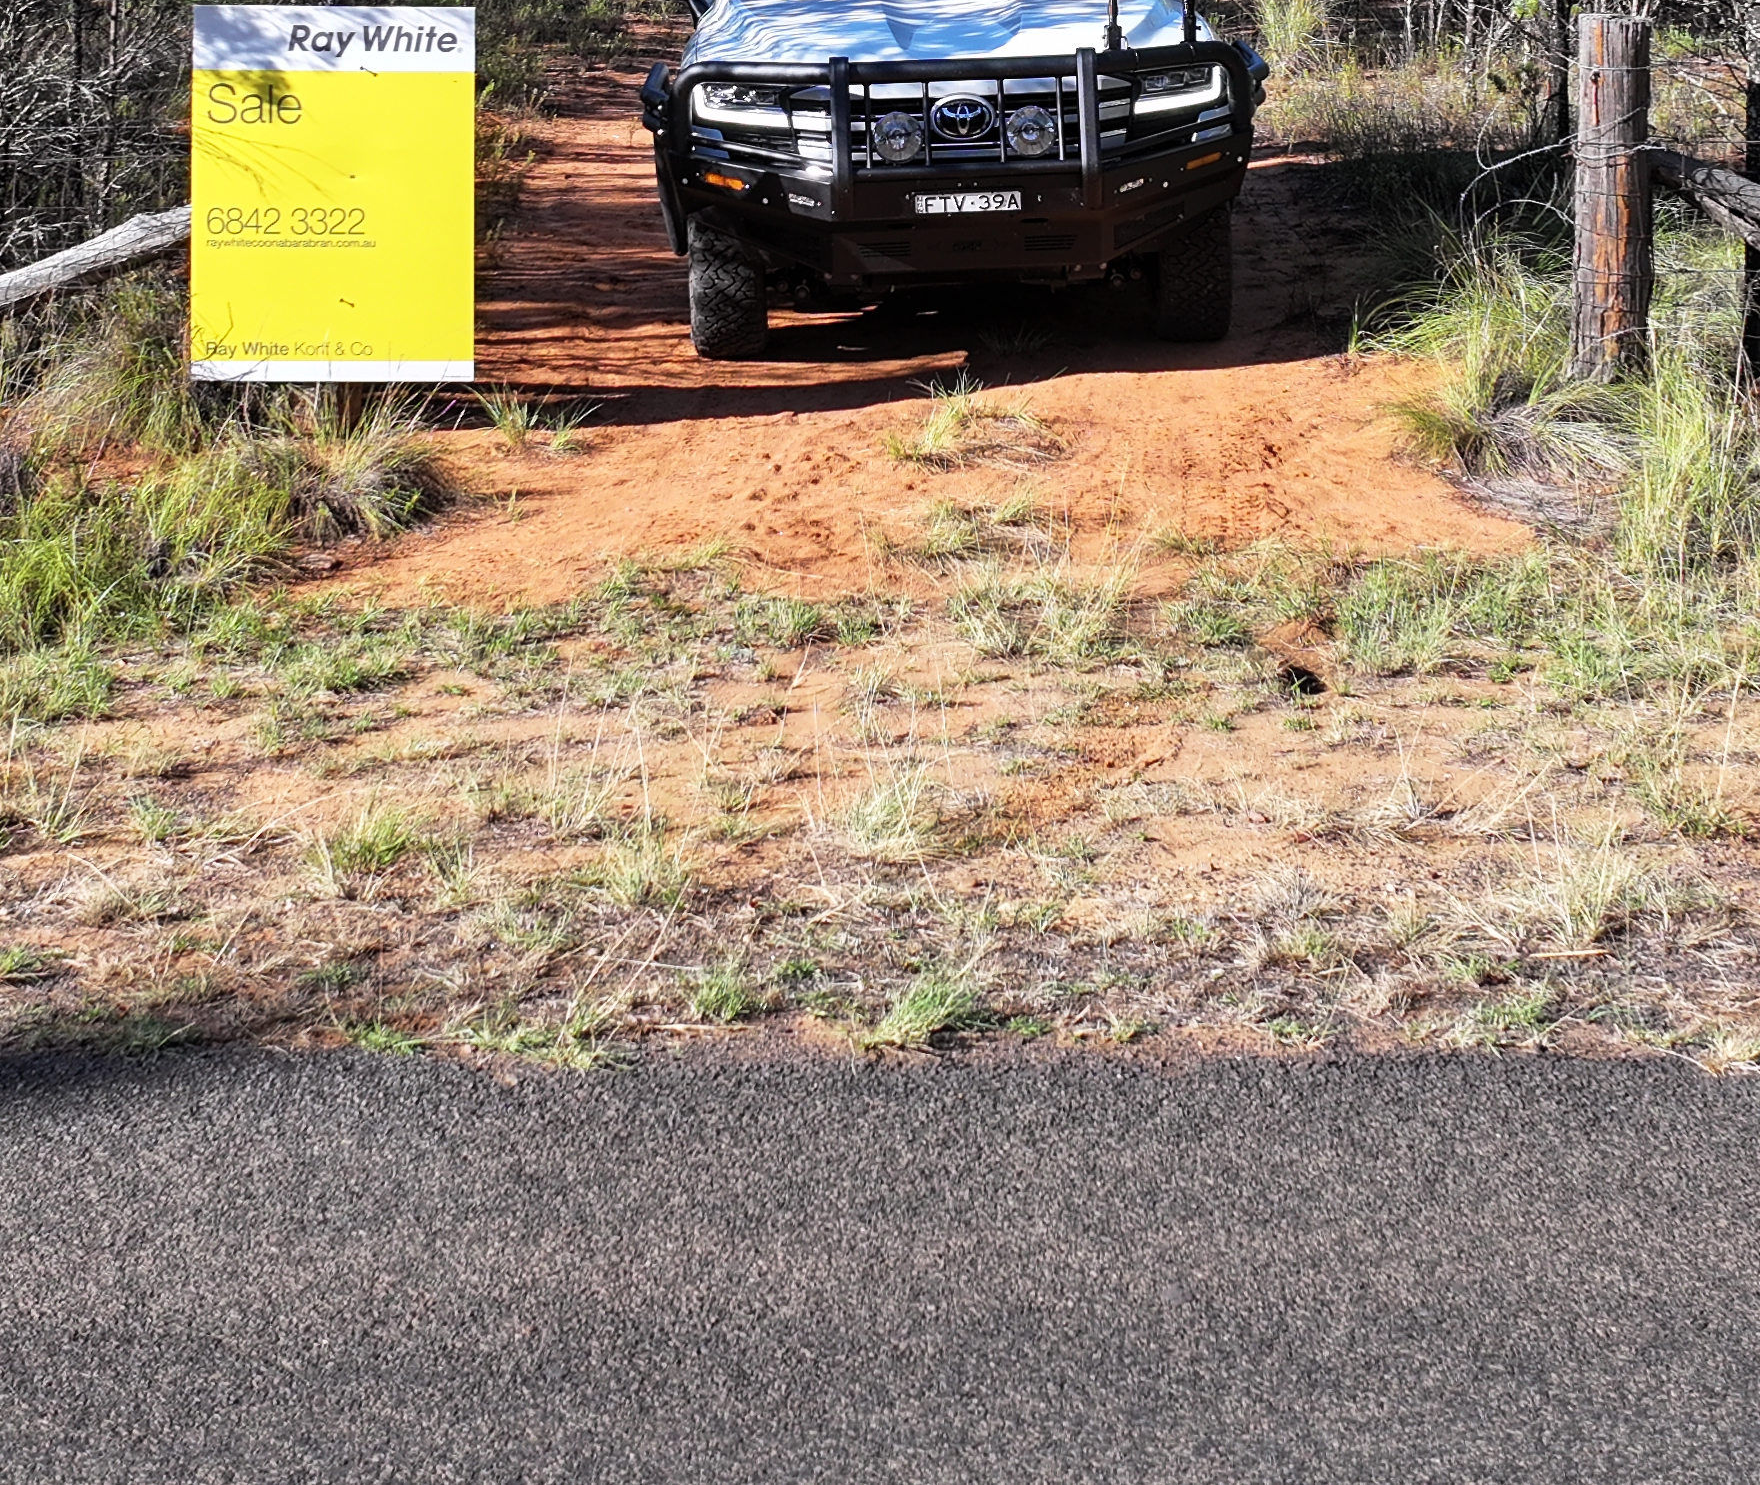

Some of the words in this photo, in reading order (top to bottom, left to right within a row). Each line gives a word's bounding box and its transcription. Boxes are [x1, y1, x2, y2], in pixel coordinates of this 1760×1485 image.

[288, 24, 356, 58] Ray
[362, 25, 458, 53] White
[207, 83, 302, 125] Sale
[206, 207, 281, 235] 6842
[290, 207, 366, 235] 3322
[206, 342, 237, 359] Ray
[242, 342, 289, 355] White
[335, 342, 345, 356] &
[350, 342, 373, 356] Co
